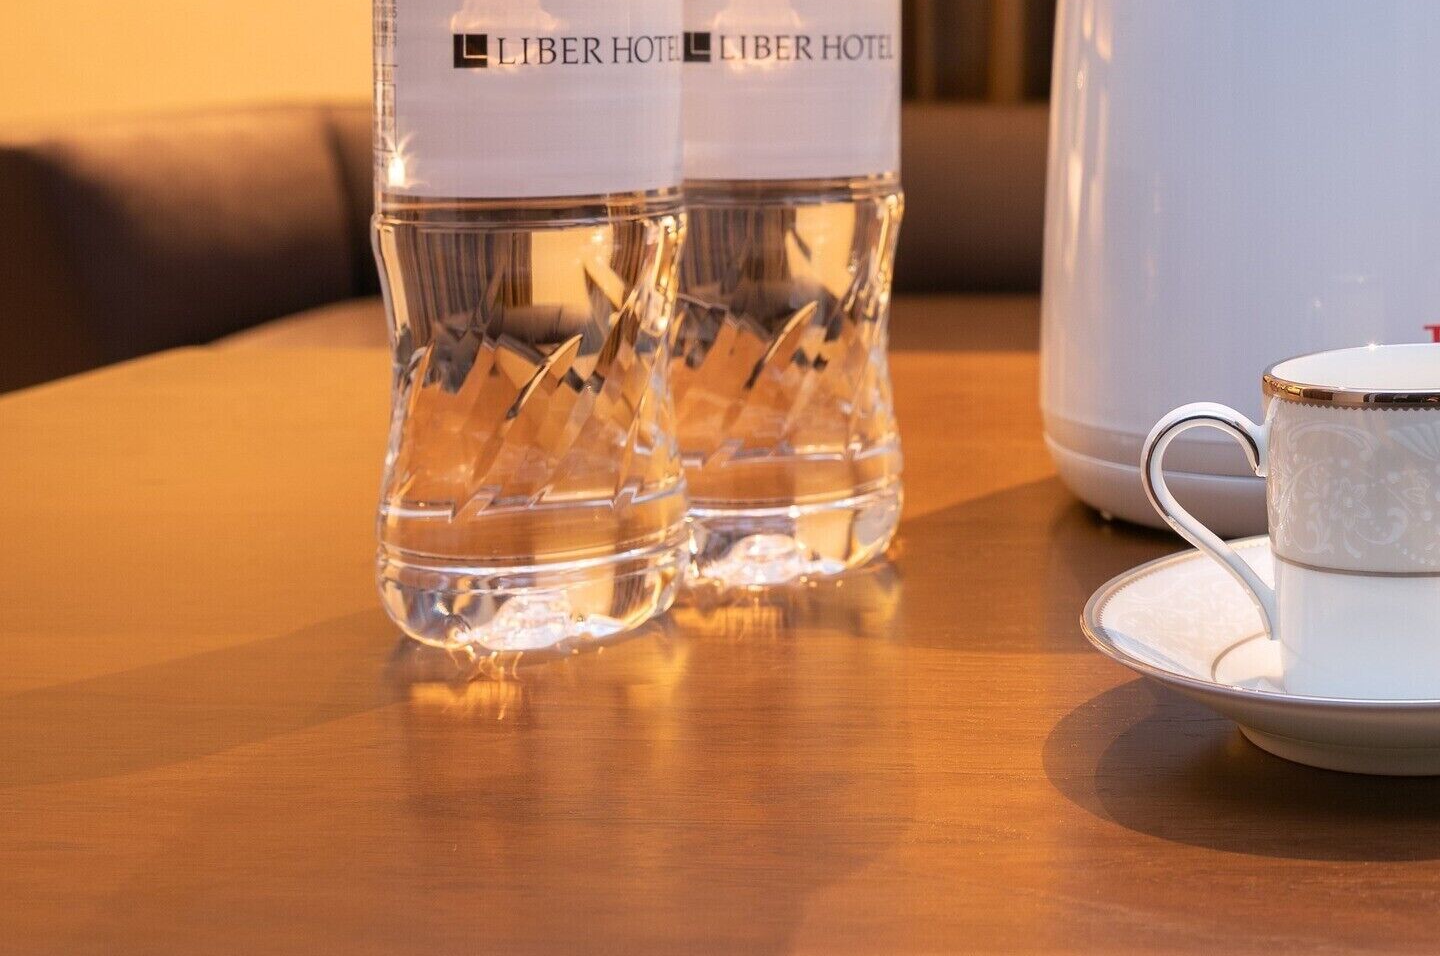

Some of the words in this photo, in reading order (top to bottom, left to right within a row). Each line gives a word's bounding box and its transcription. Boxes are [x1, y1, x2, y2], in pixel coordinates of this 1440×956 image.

[497, 36, 604, 65] LIBER
[612, 34, 681, 64] HOTEL
[719, 34, 813, 61] LIBER
[821, 33, 893, 60] HOTEL
